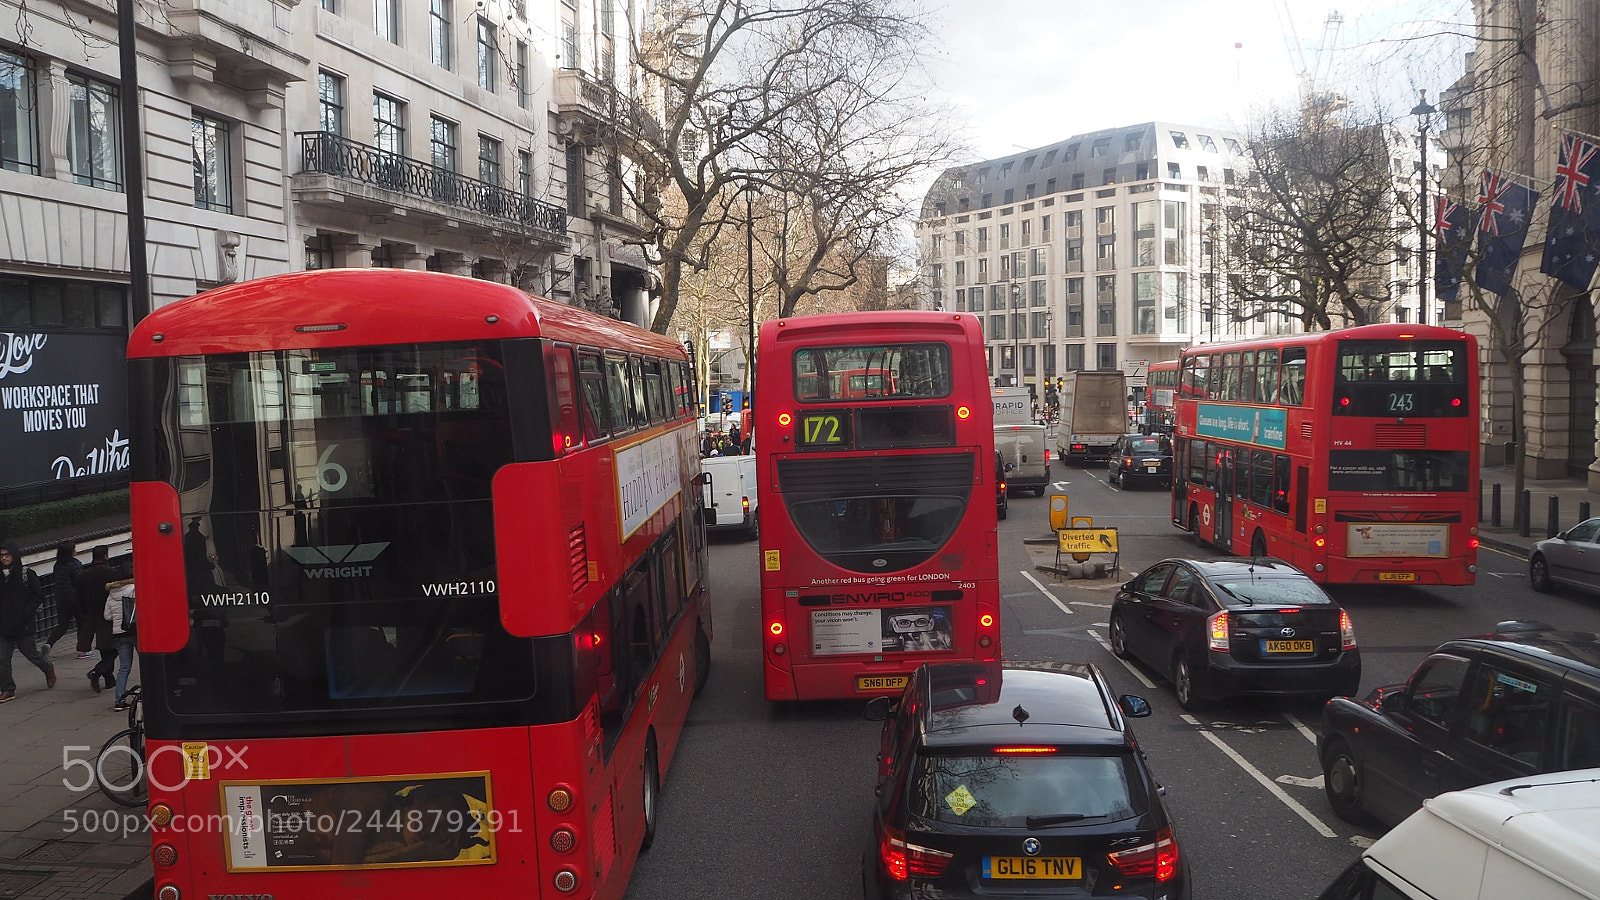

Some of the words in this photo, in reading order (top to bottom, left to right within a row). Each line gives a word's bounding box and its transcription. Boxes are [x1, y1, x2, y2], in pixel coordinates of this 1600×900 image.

[1, 385, 71, 409] WORKSPACE
[73, 384, 99, 405] THAT
[1390, 393, 1414, 410] 243
[996, 402, 1024, 410] RAPID
[23, 409, 63, 432] MOVES
[65, 408, 86, 428] YOU
[804, 416, 840, 442] 172
[86, 429, 130, 476] Wha
[317, 444, 348, 492] 6
[304, 566, 373, 580] WRIGHT
[867, 576, 886, 584] going
[422, 580, 496, 597] VWH2110
[201, 592, 270, 607] VWH2110
[1268, 642, 1291, 650] AK60
[864, 679, 884, 688] SN61
[885, 678, 903, 687] DFP
[245, 796, 254, 809] the
[238, 796, 249, 850] impressionists
[1110, 836, 1142, 845] X3
[998, 859, 1036, 875] GL16
[1041, 859, 1076, 875] TNV
